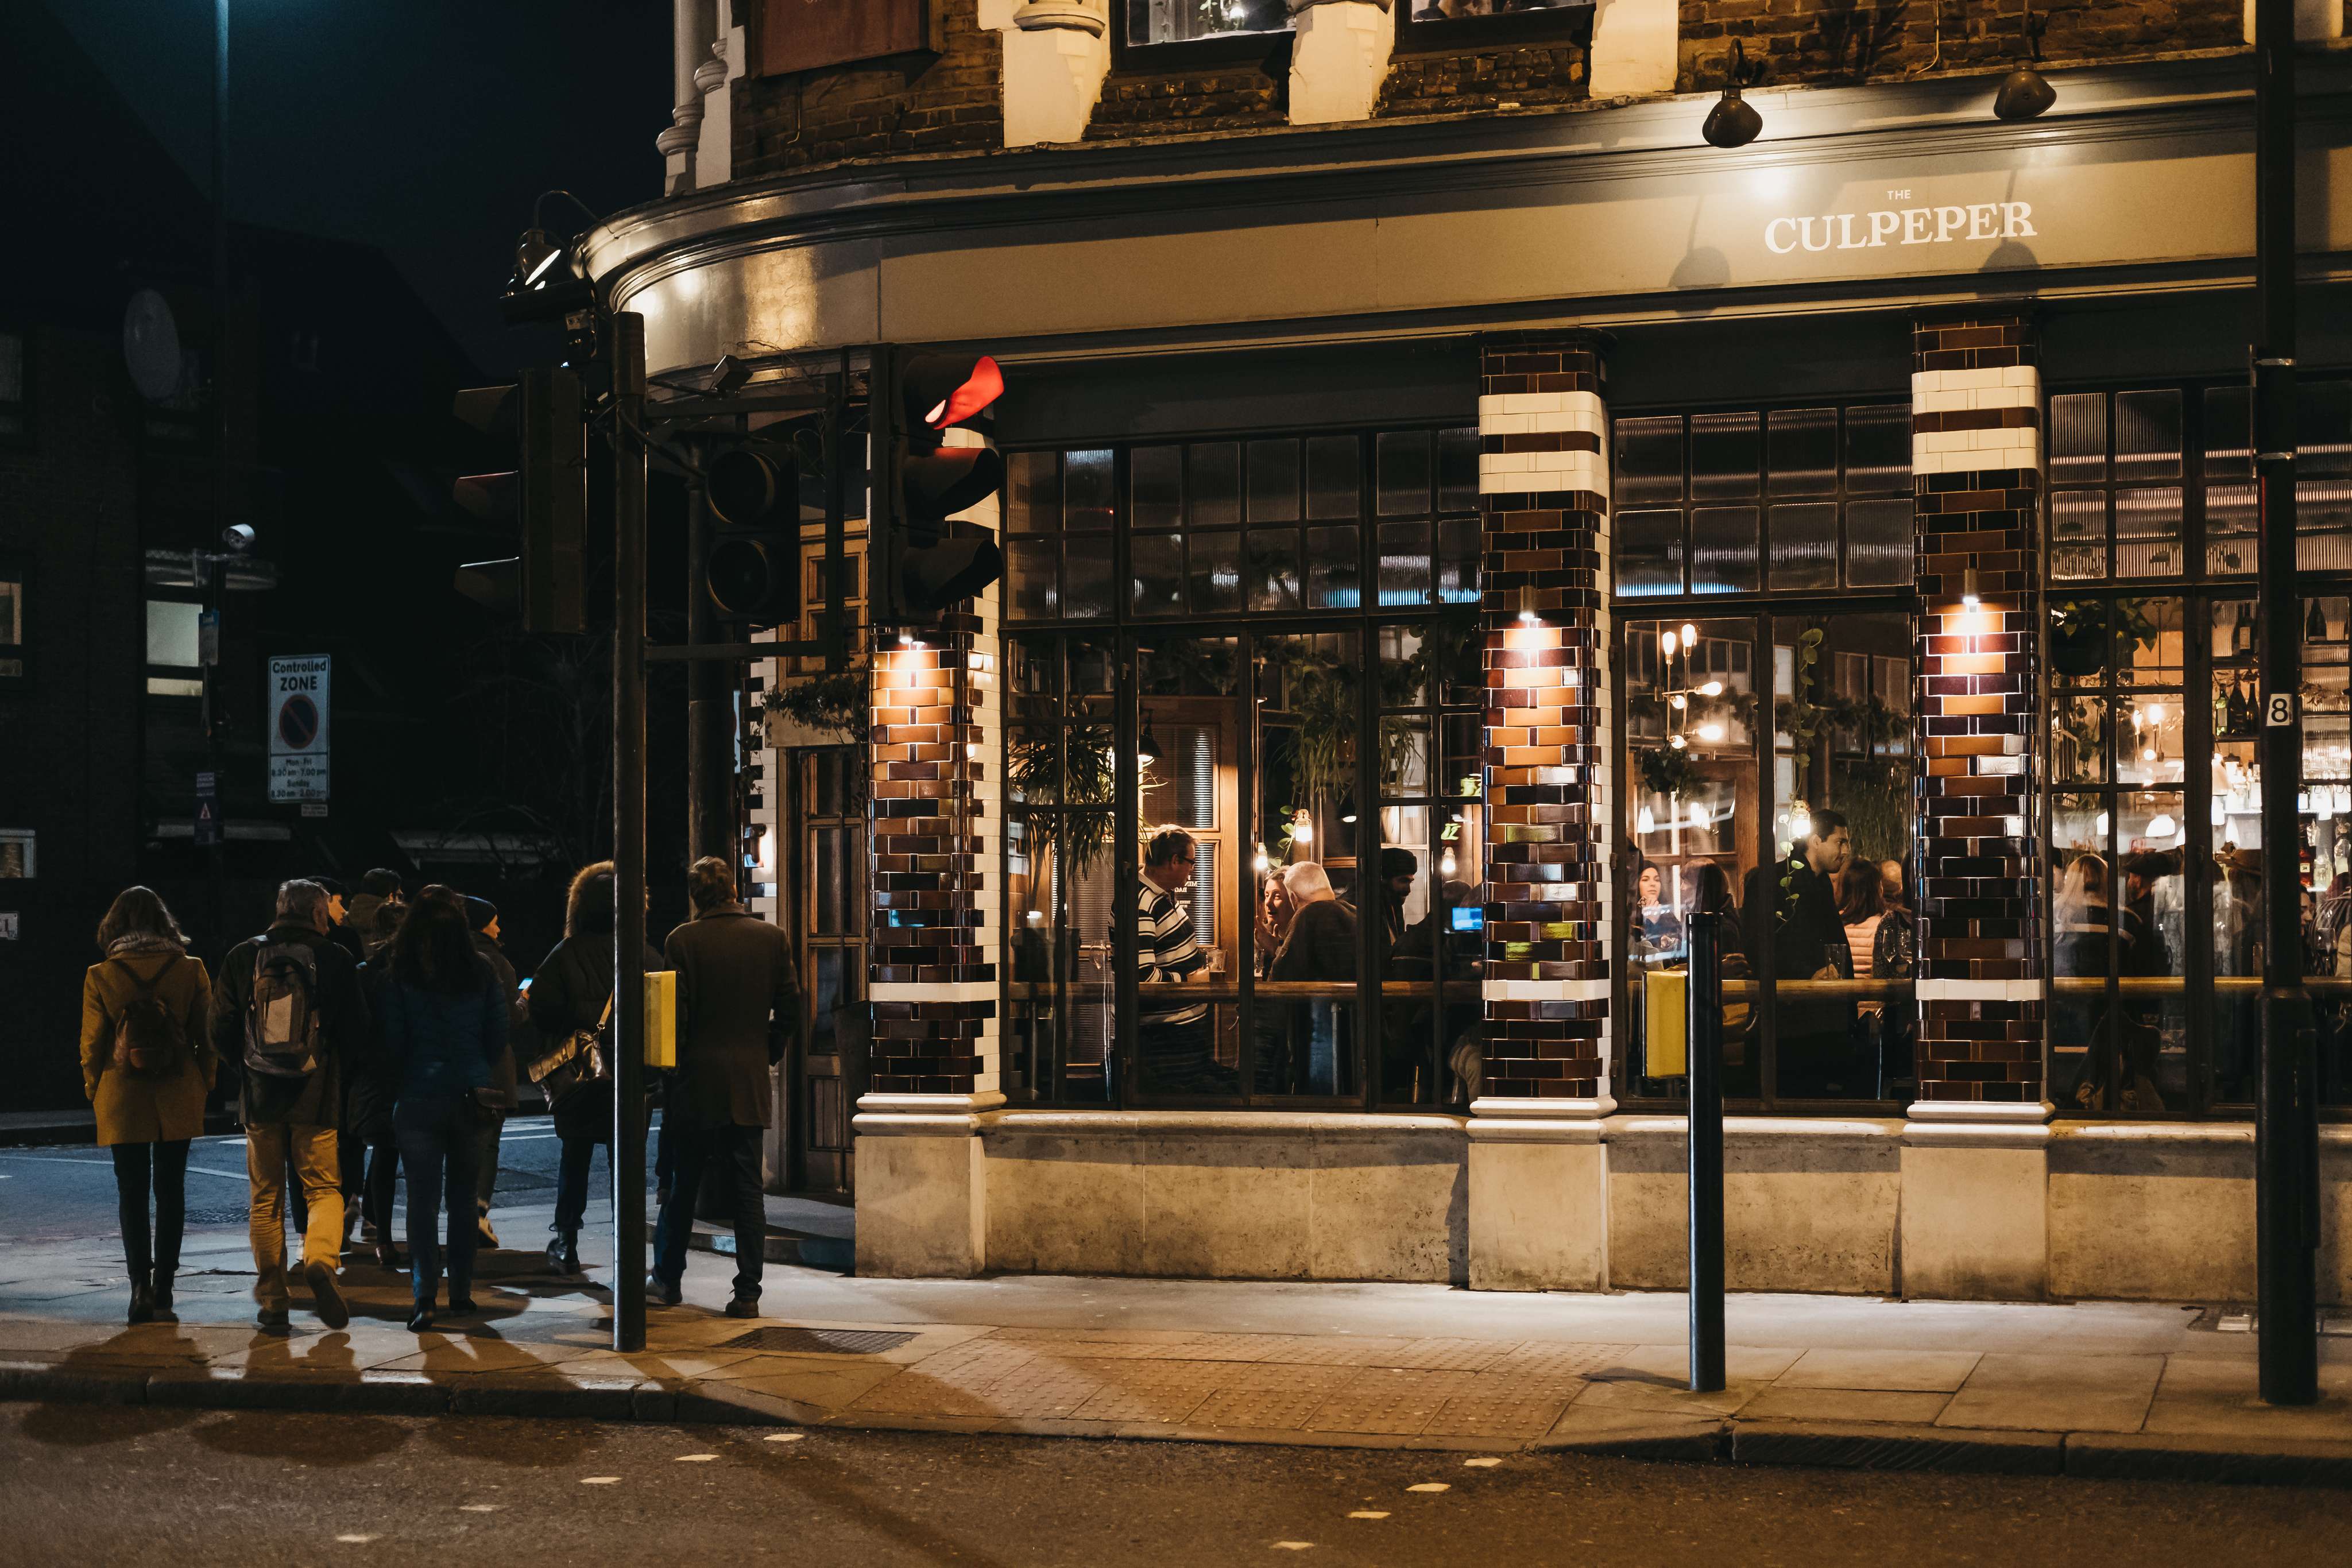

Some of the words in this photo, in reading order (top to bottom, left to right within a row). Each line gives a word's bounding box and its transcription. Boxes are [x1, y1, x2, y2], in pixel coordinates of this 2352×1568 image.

[1887, 189, 1911, 200] THE
[1765, 202, 2038, 254] CULPEPER
[273, 660, 326, 673] Controlled
[280, 676, 318, 691] ZONE
[2271, 698, 2288, 722] 8
